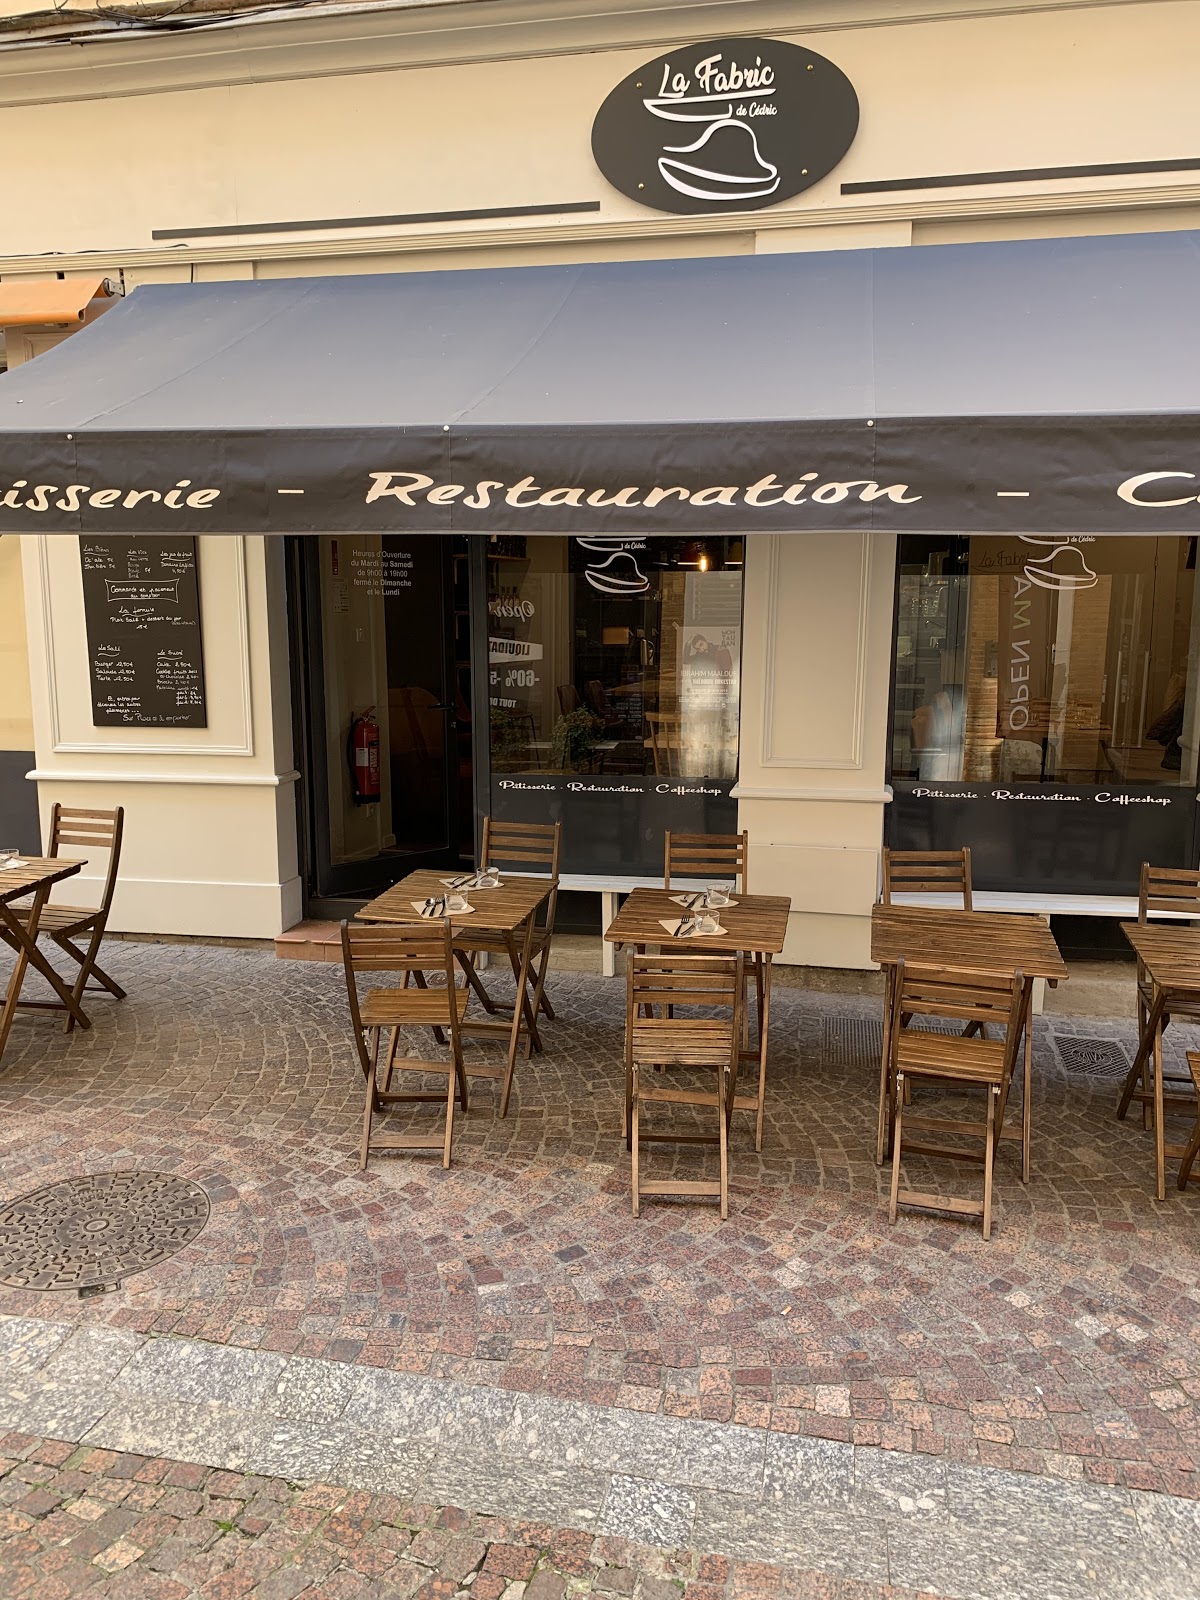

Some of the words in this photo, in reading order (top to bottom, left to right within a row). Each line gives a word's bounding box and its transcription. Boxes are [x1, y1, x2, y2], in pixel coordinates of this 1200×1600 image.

[658, 63, 690, 98] La
[694, 53, 775, 94] Fabric
[736, 105, 748, 117] de
[749, 102, 777, 117] Cédric
[0, 479, 221, 512] isserie
[364, 471, 922, 509] Restauration
[1117, 471, 1200, 507] C
[352, 549, 375, 558] Heures
[376, 550, 411, 559] d'Ouverture
[361, 559, 379, 567] Mardi
[389, 560, 414, 569] Samedi
[366, 569, 383, 577] 9h00
[384, 569, 388, 577] à
[389, 570, 408, 578] 19h00
[353, 578, 372, 586] fermé
[373, 578, 379, 586] le
[380, 578, 412, 587] Dimanche
[375, 588, 381, 596] le
[381, 588, 400, 596] Lundi
[567, 781, 645, 793] Restauration
[991, 789, 1082, 802] Restauration
